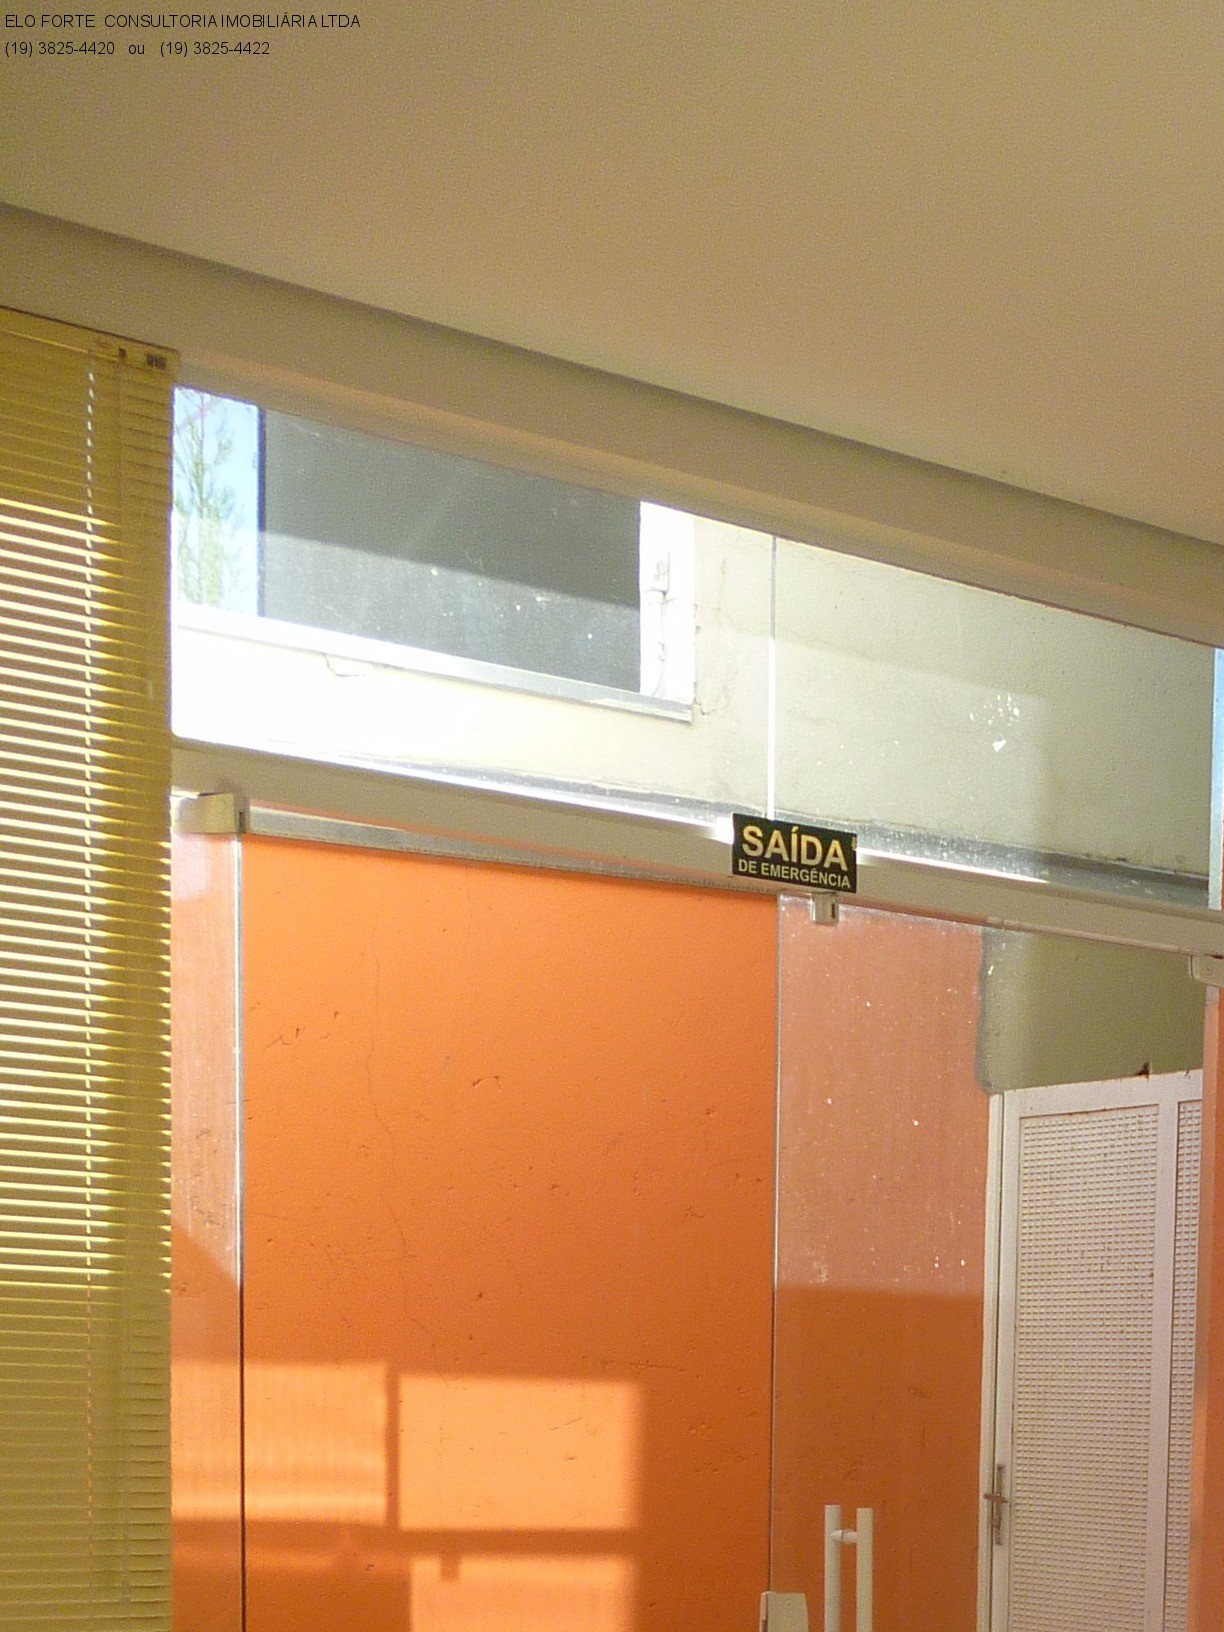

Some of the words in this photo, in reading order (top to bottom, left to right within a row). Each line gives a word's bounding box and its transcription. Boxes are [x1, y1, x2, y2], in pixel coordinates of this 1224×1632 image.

[742, 825, 848, 871] SAÍDA
[738, 858, 757, 874] DE
[761, 862, 851, 888] EMERGÊNCIA
